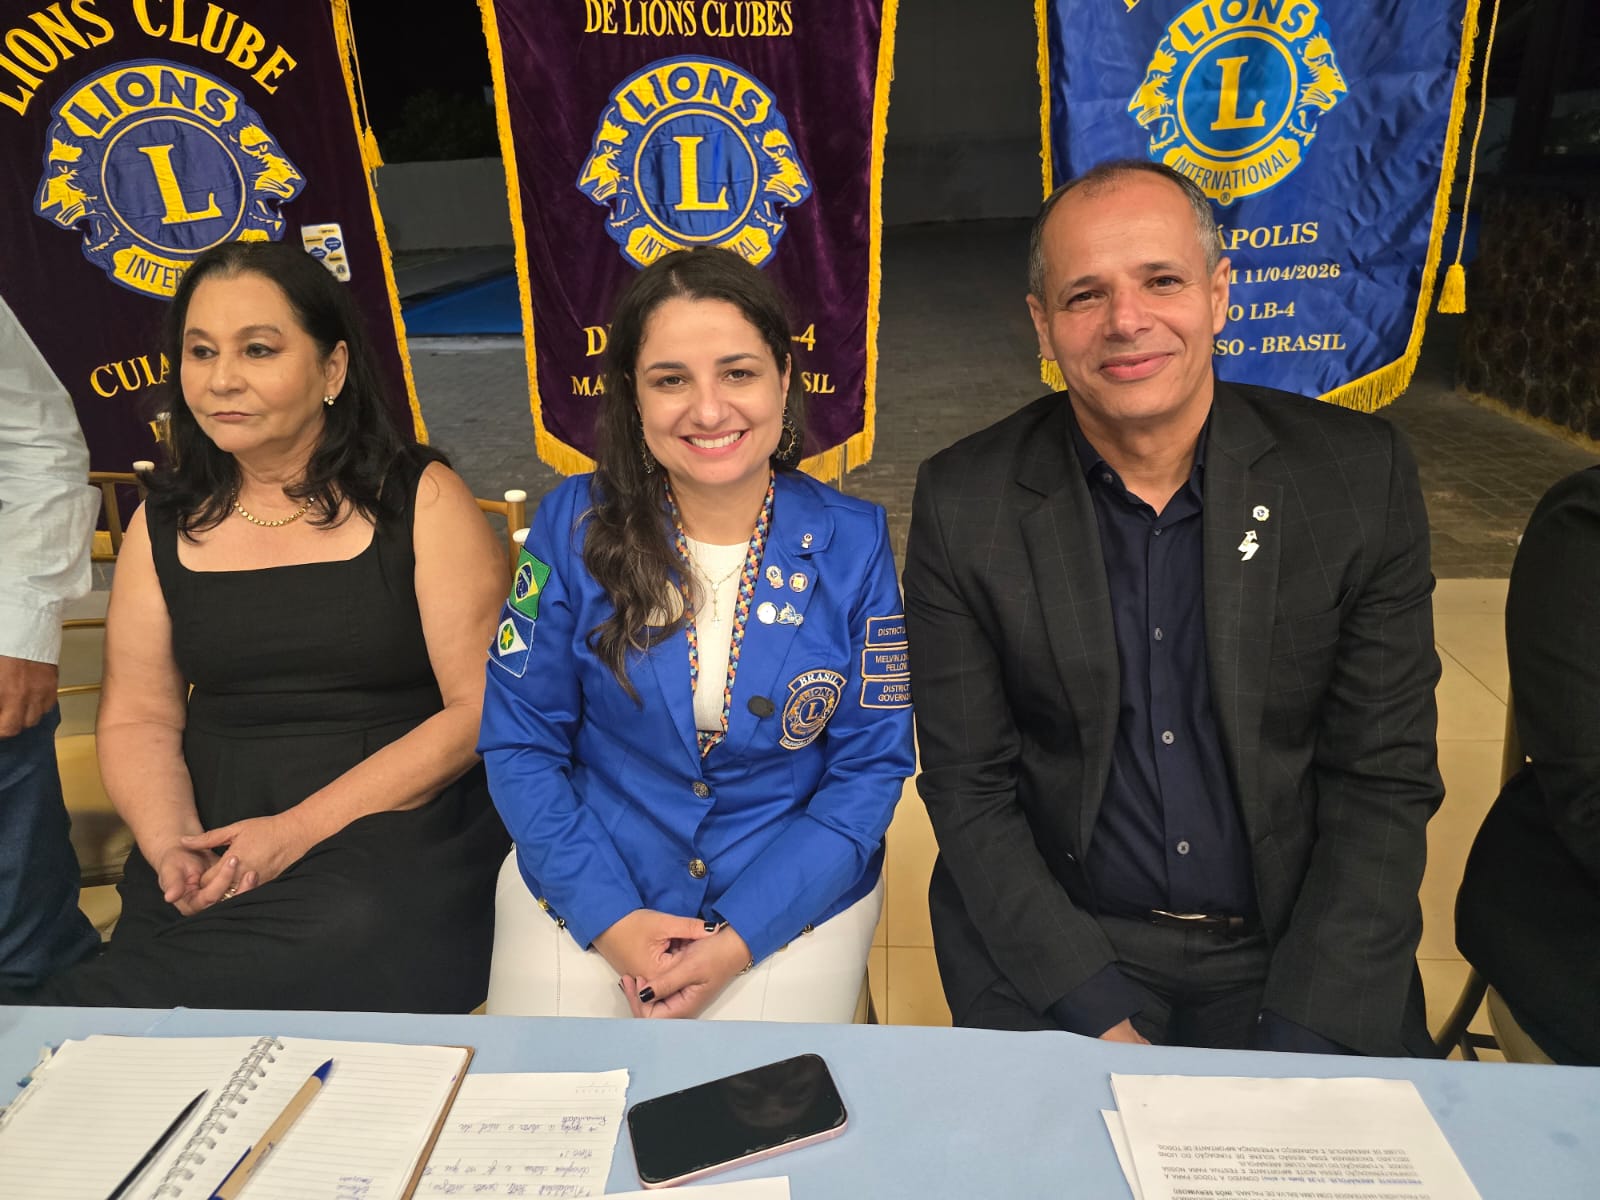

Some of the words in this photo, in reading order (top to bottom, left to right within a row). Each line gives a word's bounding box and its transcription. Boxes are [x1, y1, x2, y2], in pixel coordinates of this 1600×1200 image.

[584, 0, 618, 34] DE
[623, 0, 697, 36] LIONS
[701, 0, 793, 37] CLUBES
[1178, 0, 1311, 46] LIONS
[132, 0, 298, 95] CLUBE
[68, 70, 230, 135] LIONS
[624, 66, 763, 120] LIONS
[1210, 55, 1266, 132] L
[138, 143, 222, 225] L
[673, 135, 729, 211] L
[1172, 149, 1292, 190] INTERNATIONAL
[1216, 221, 1319, 250] ÁPOLIS
[1244, 263, 1341, 284] 11/04/2026
[1249, 301, 1295, 320] LB-4
[1261, 333, 1346, 354] BRASIL
[799, 672, 840, 687] BRASIL
[806, 702, 819, 721] L
